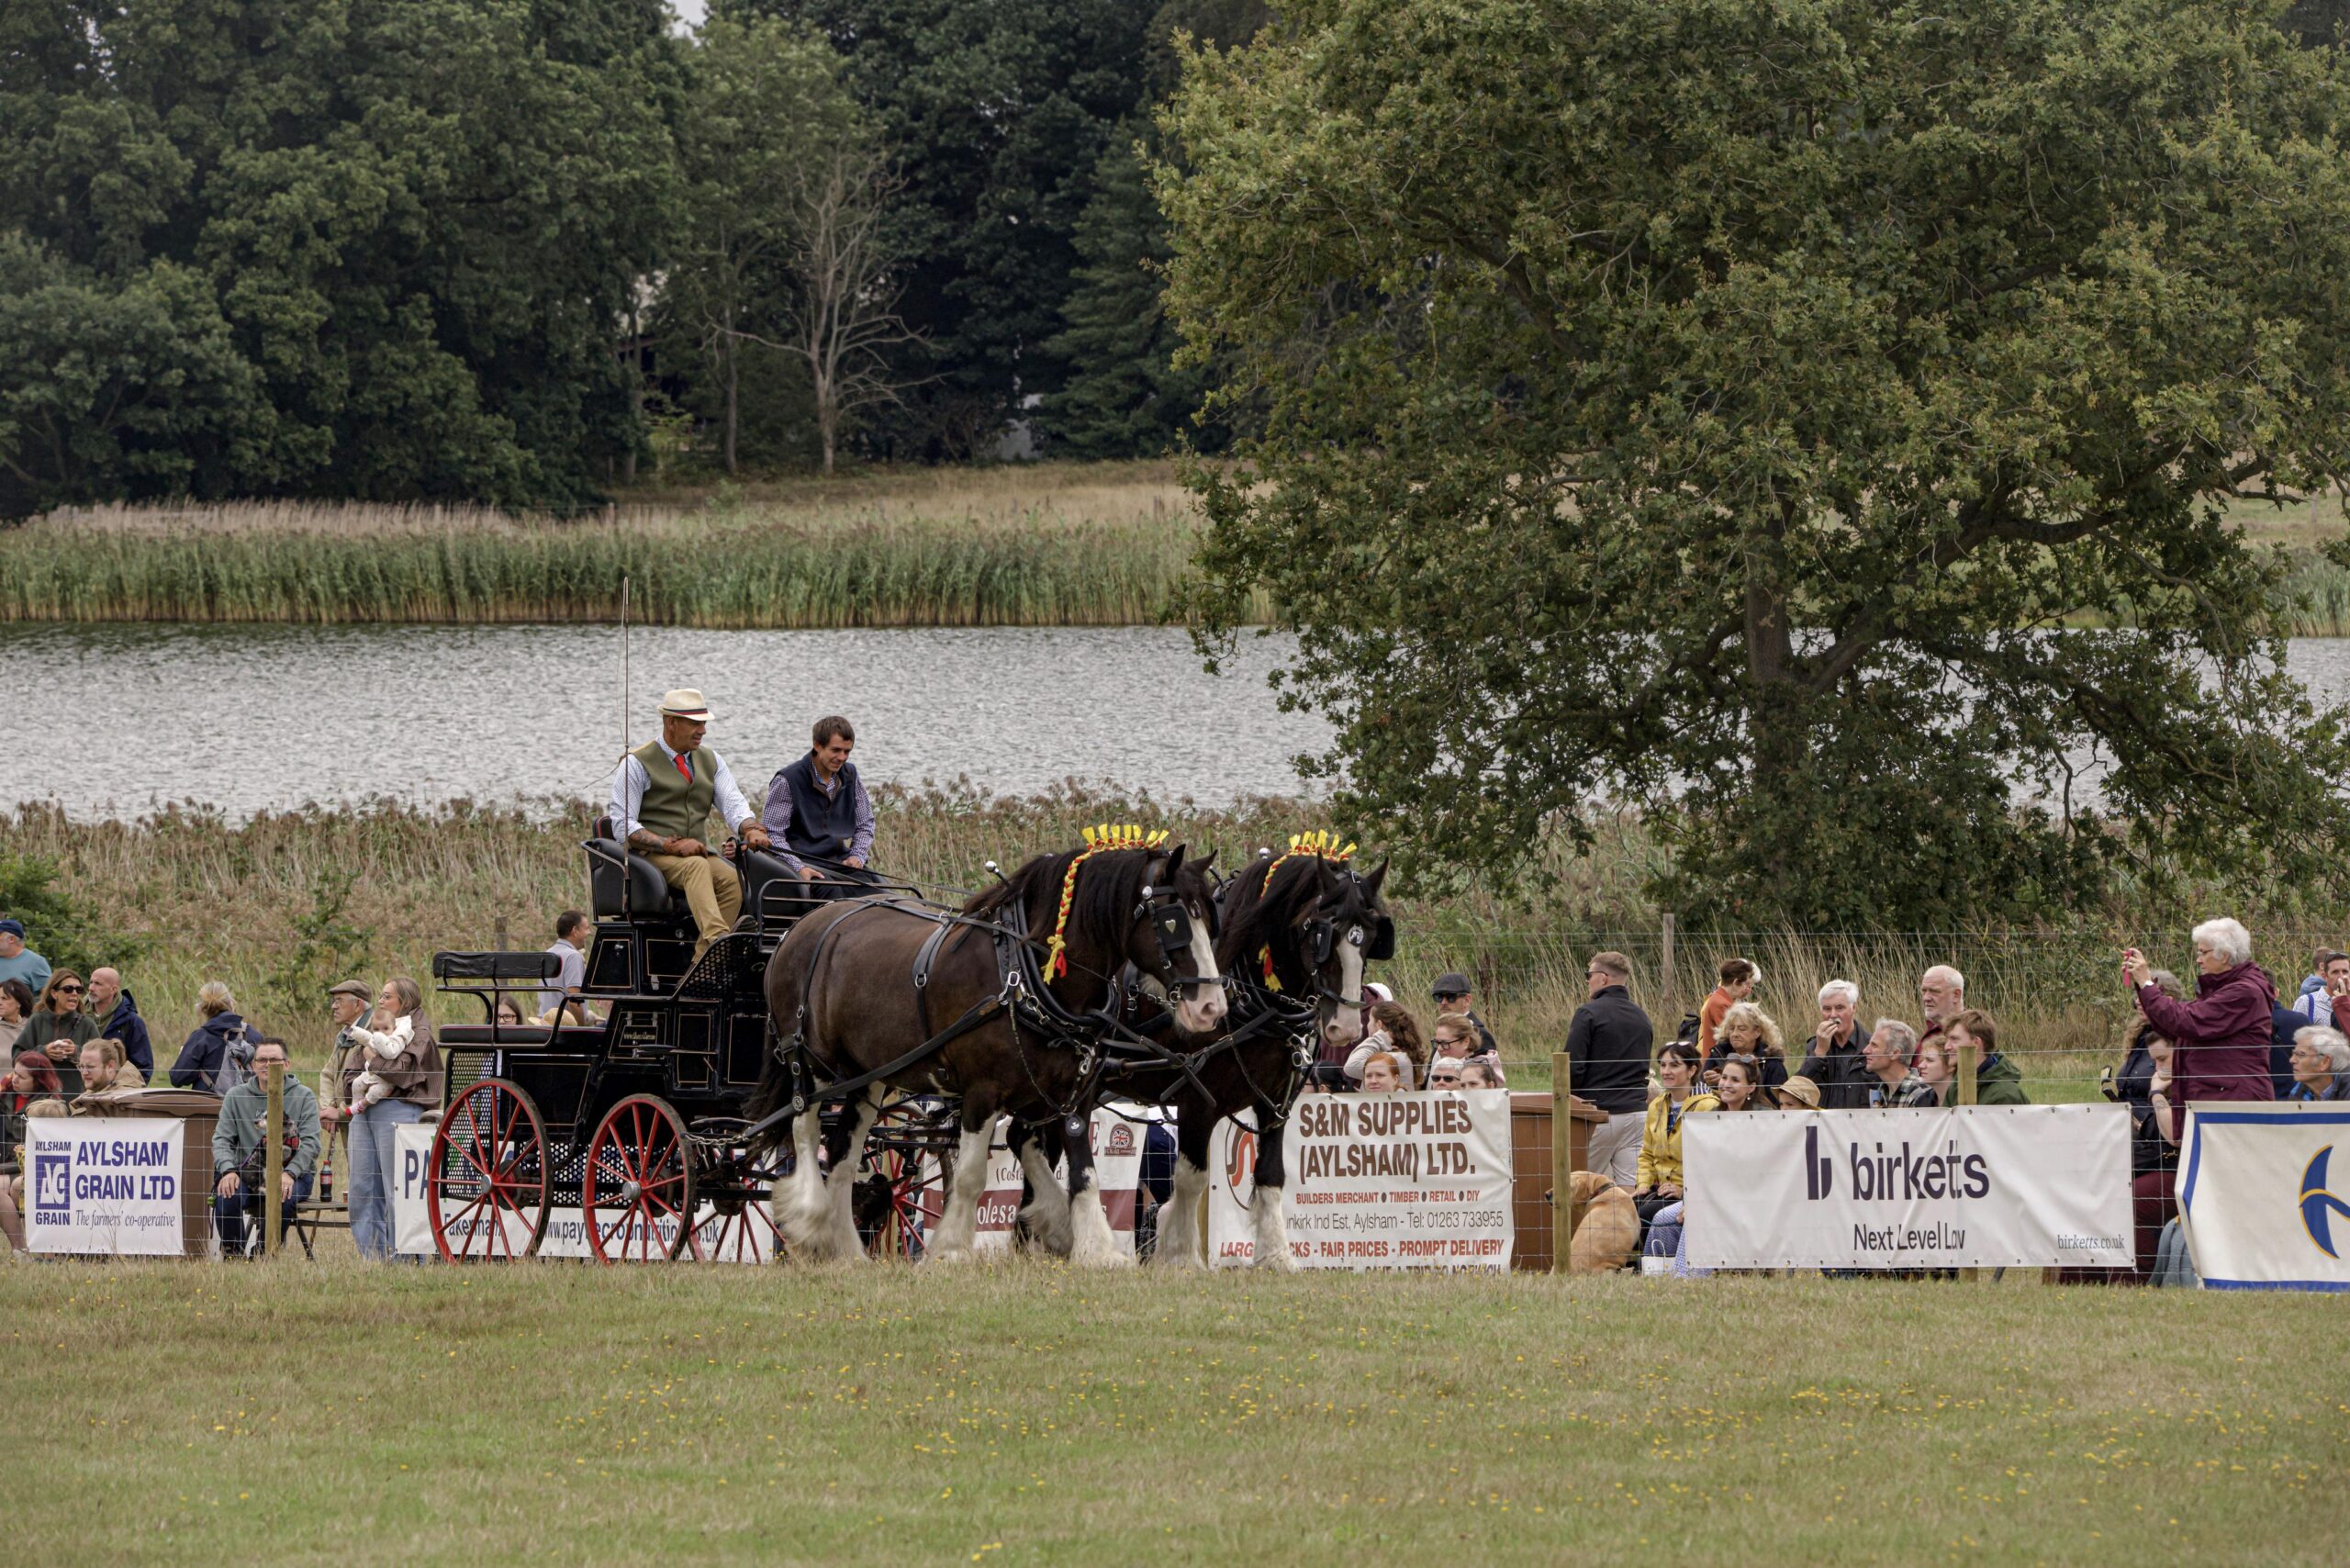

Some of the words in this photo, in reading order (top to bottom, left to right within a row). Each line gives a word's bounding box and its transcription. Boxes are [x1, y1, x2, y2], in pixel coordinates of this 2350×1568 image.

[1299, 1103, 1350, 1137] S&M
[1357, 1100, 1473, 1137] SUPPLIES
[35, 1141, 72, 1152] AYLSHAM
[76, 1141, 169, 1167] AYLSHAM
[1300, 1143, 1419, 1184] (AYLSHAM)
[1427, 1142, 1475, 1176] LTD.
[75, 1175, 134, 1201] GRAIN
[140, 1175, 175, 1201] LTD
[1296, 1193, 1334, 1204] BUILDERS
[1336, 1192, 1379, 1204] MERCHANT
[1389, 1191, 1419, 1203] TIMBER
[1428, 1190, 1457, 1203] RETAIL
[1466, 1190, 1480, 1202] DIY
[35, 1212, 71, 1226] GRAIN
[76, 1209, 90, 1226] The
[90, 1209, 124, 1231] farmers'
[125, 1212, 175, 1231] co-operative
[1286, 1213, 1312, 1230] unkirk
[1315, 1213, 1329, 1230] Ind
[1332, 1213, 1351, 1232] Est,
[1354, 1212, 1398, 1234] Aylsham
[1407, 1211, 1425, 1229] Tel:
[1427, 1211, 1460, 1228] 01263
[1462, 1210, 1504, 1228] 733955
[1853, 1224, 1894, 1251] Next
[1897, 1221, 1942, 1251] Level
[2056, 1233, 2126, 1249] birketts.co.uk
[1220, 1241, 1254, 1258] LARG
[1320, 1241, 1345, 1258] FAIR
[1348, 1240, 1389, 1258] PRICES
[1399, 1239, 1448, 1257] PROMPT
[1449, 1238, 1505, 1257] DELIVERY
